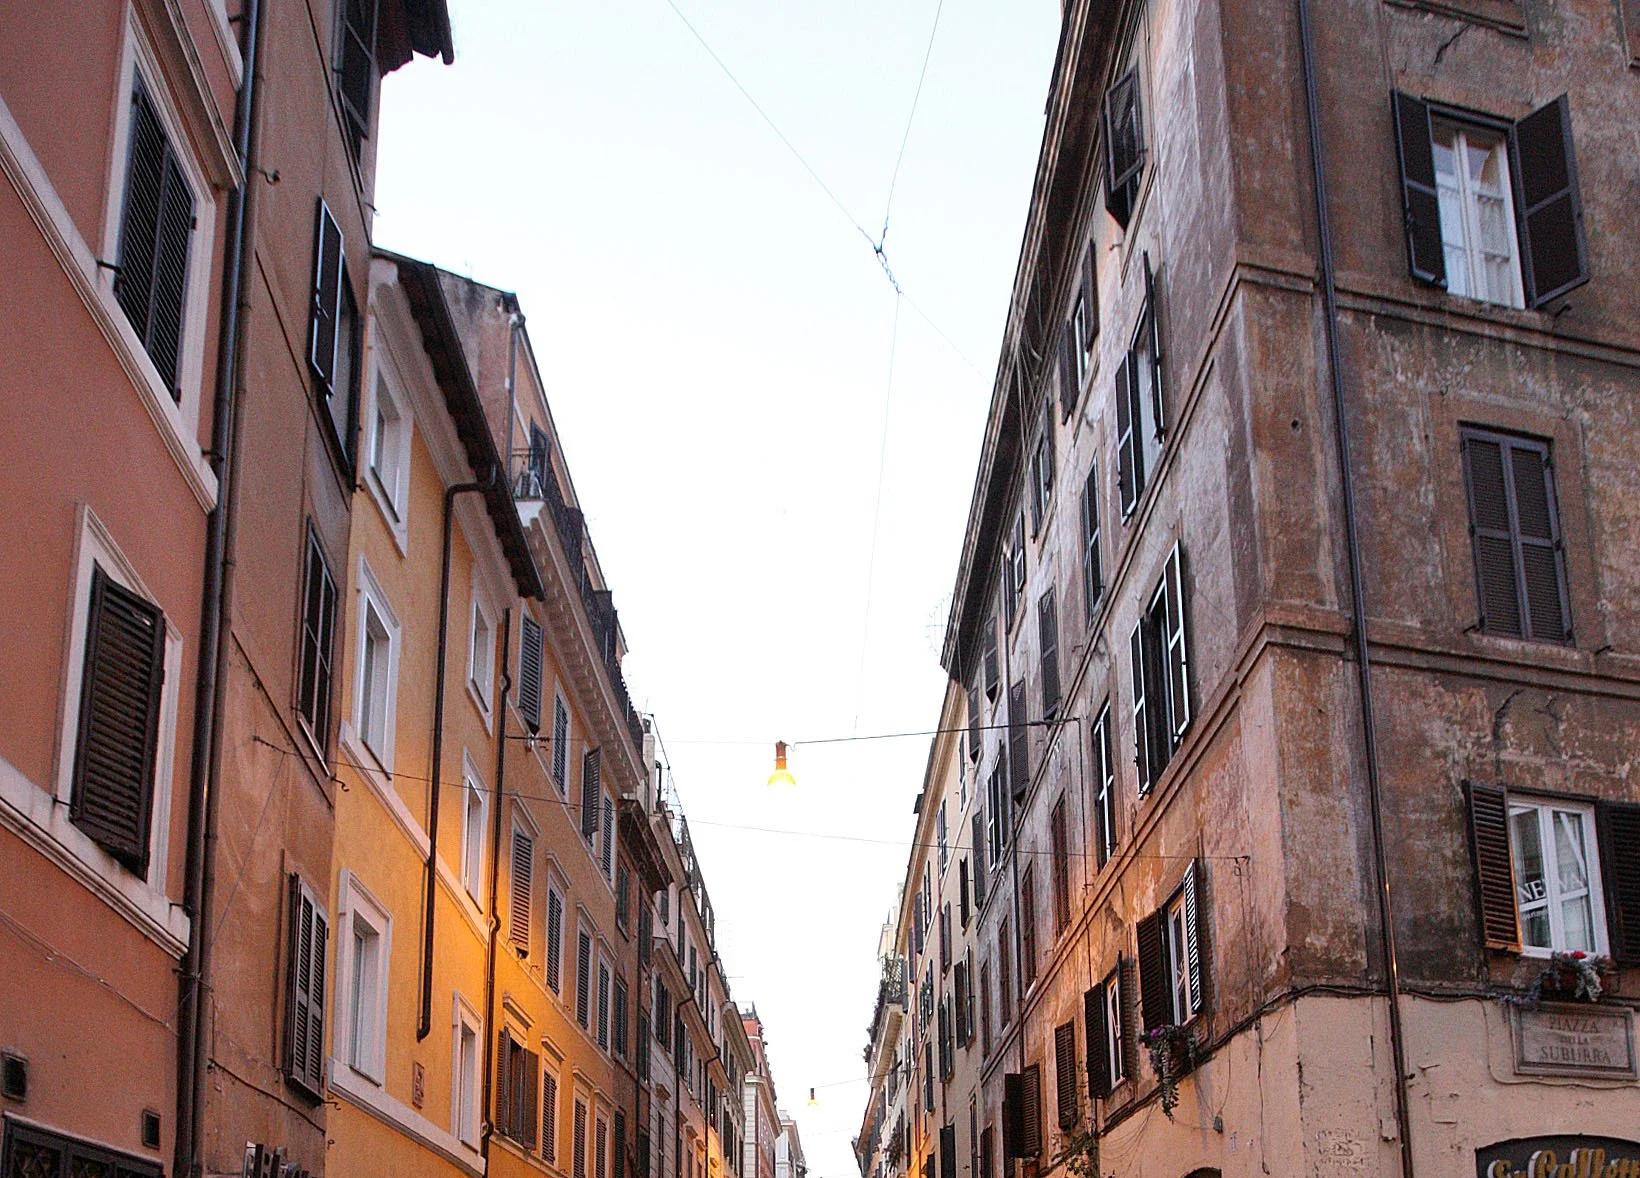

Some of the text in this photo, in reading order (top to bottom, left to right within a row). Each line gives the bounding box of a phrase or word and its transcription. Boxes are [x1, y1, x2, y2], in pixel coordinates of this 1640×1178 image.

[1549, 1015, 1599, 1033] PIAZZA
[1560, 1035, 1590, 1045] DELLA
[1541, 1046, 1611, 1063] SUBURRA
